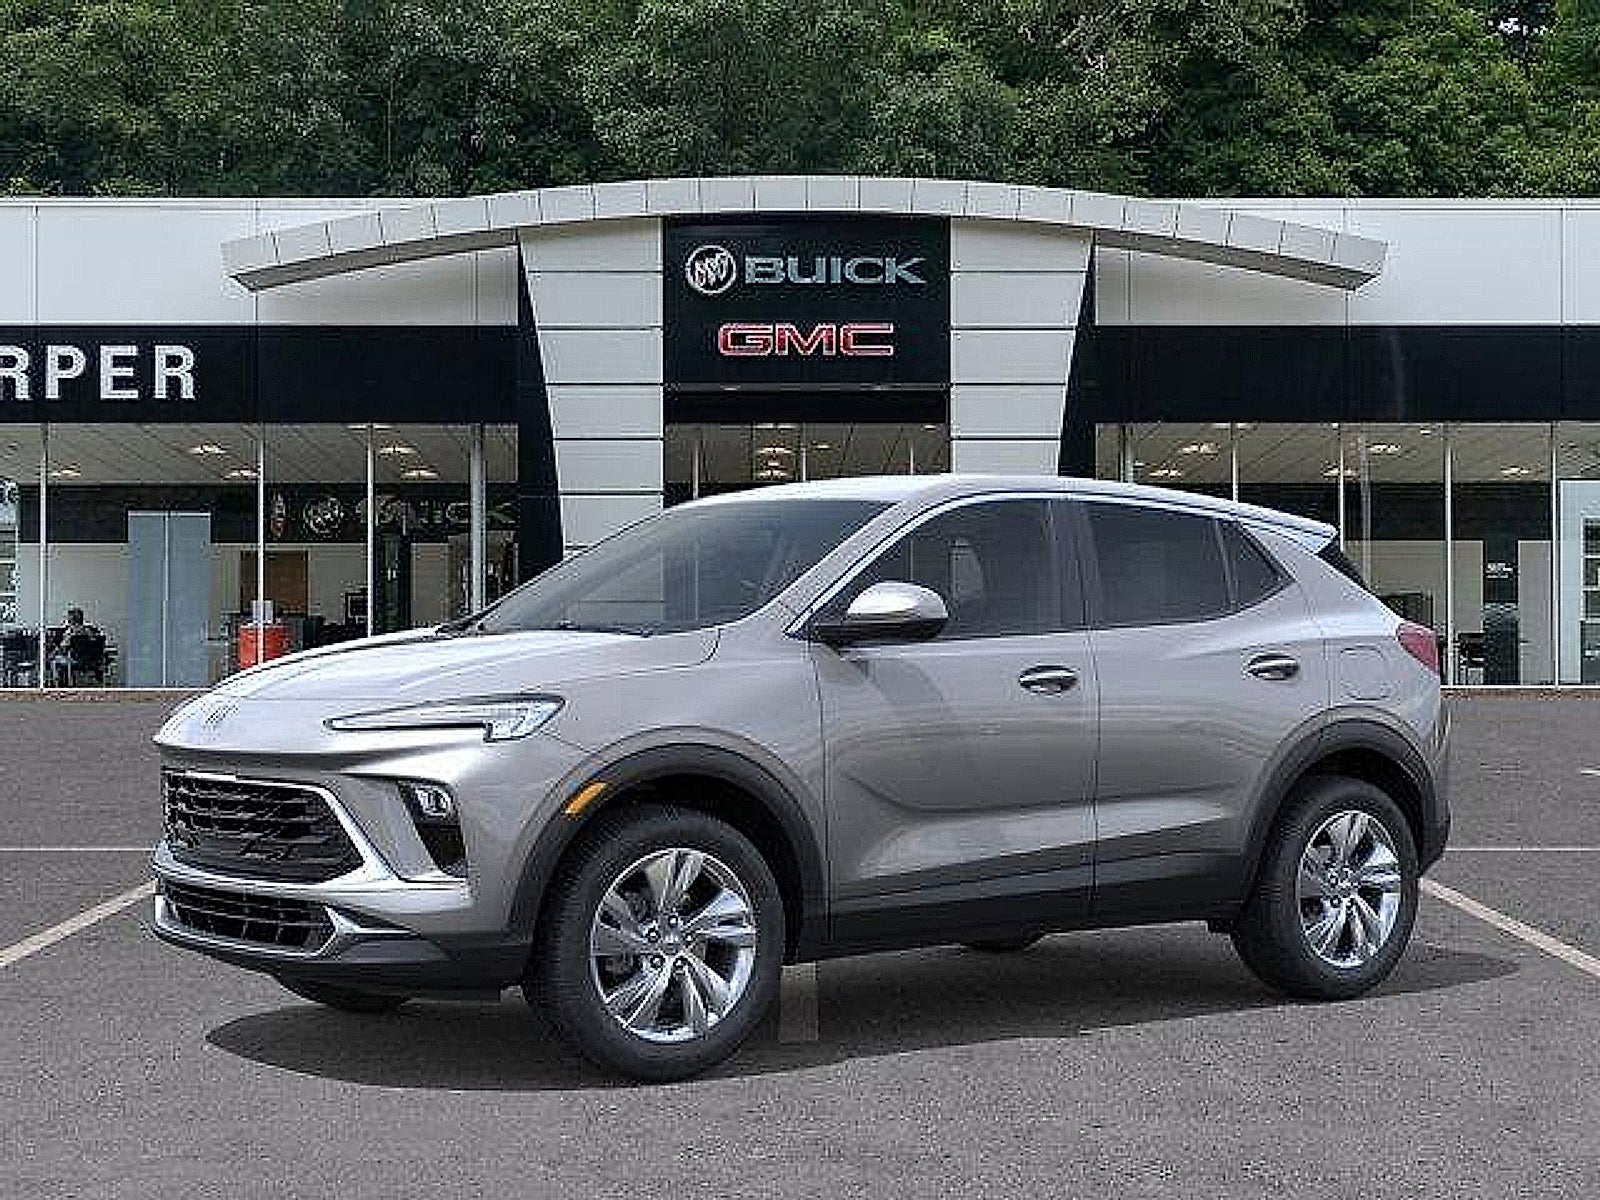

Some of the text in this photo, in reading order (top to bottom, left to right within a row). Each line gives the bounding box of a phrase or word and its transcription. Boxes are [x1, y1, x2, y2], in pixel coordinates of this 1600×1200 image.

[744, 257, 926, 284] BUICK
[719, 322, 894, 356] GMC
[0, 344, 195, 399] RPER
